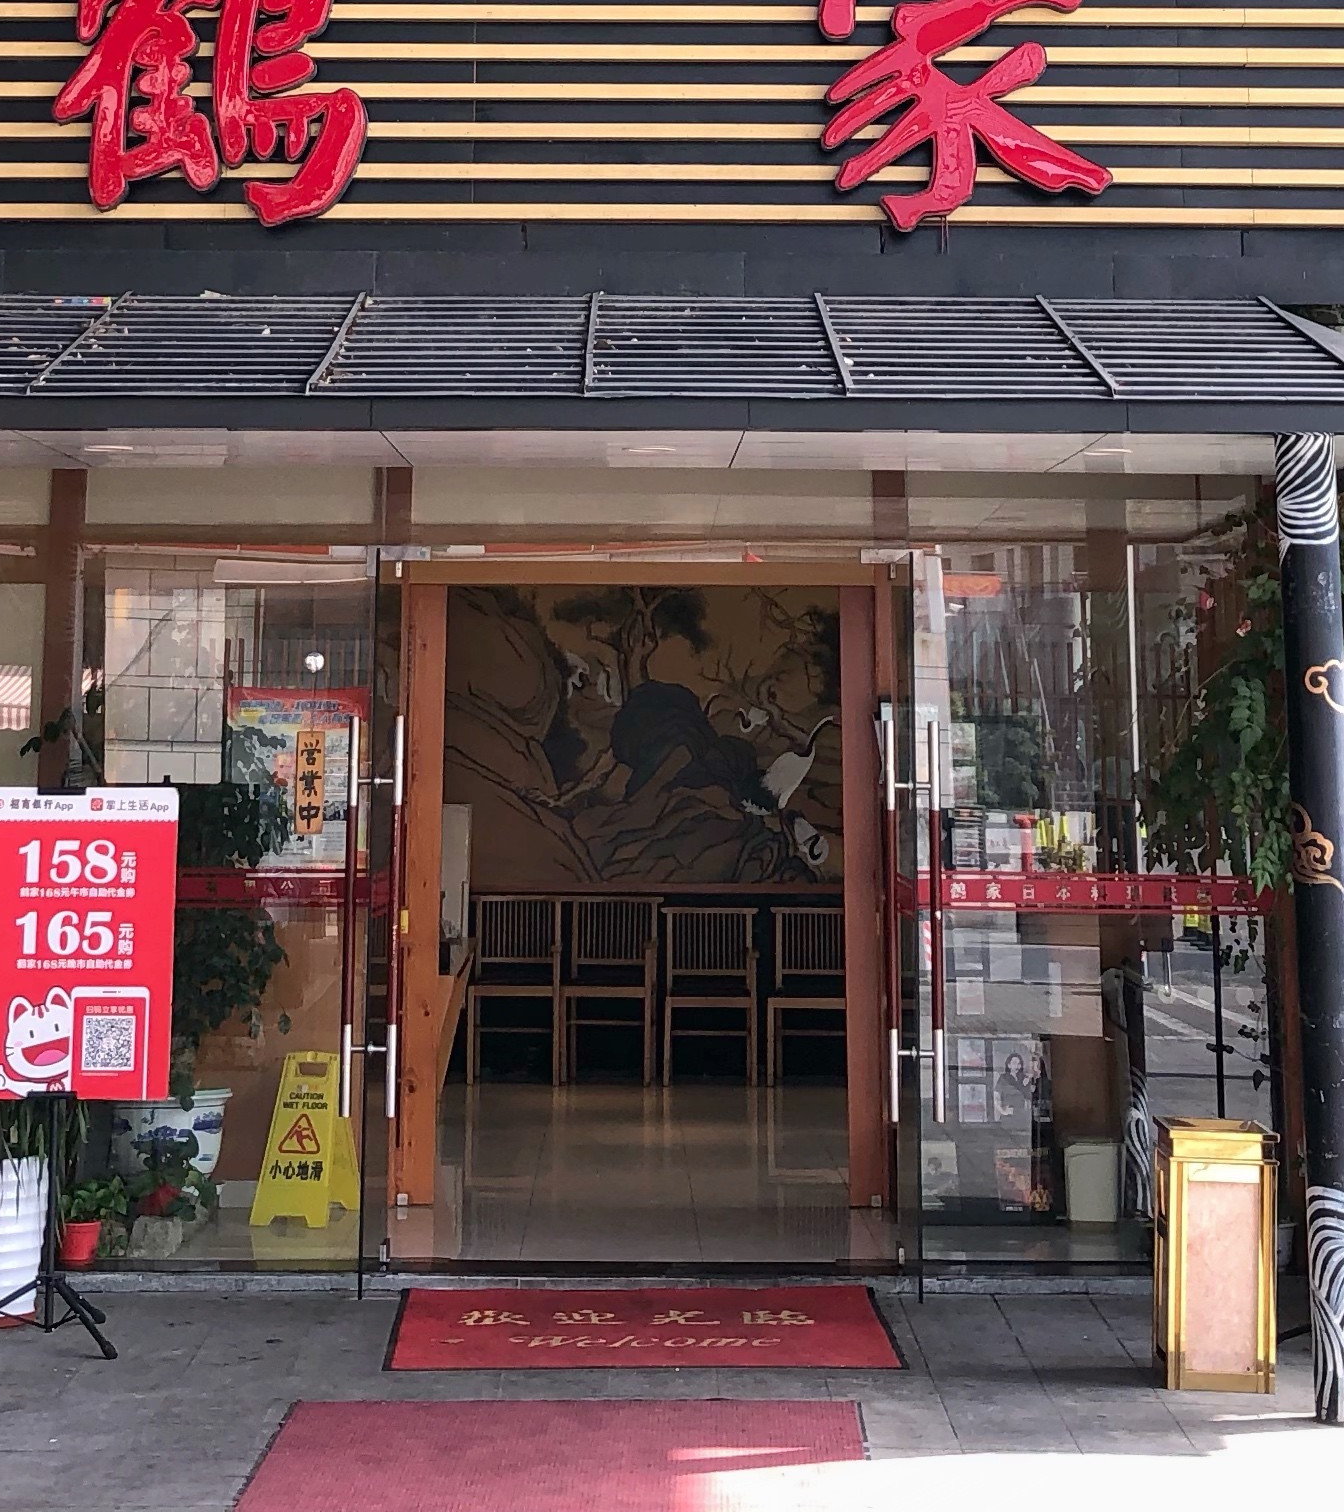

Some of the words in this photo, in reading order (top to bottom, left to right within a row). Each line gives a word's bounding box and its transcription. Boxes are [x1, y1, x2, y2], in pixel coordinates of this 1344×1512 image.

[106, 799, 169, 812] 掌上生活App
[18, 839, 118, 884] 158
[120, 851, 137, 884] 元购
[15, 910, 114, 956] 165
[117, 923, 135, 956] 元购
[289, 1092, 324, 1100] CAUTION
[283, 1101, 299, 1109] WET
[302, 1101, 328, 1109] FLOOR
[269, 1159, 324, 1181] 小心地滑
[509, 1335, 783, 1349] Welcome
